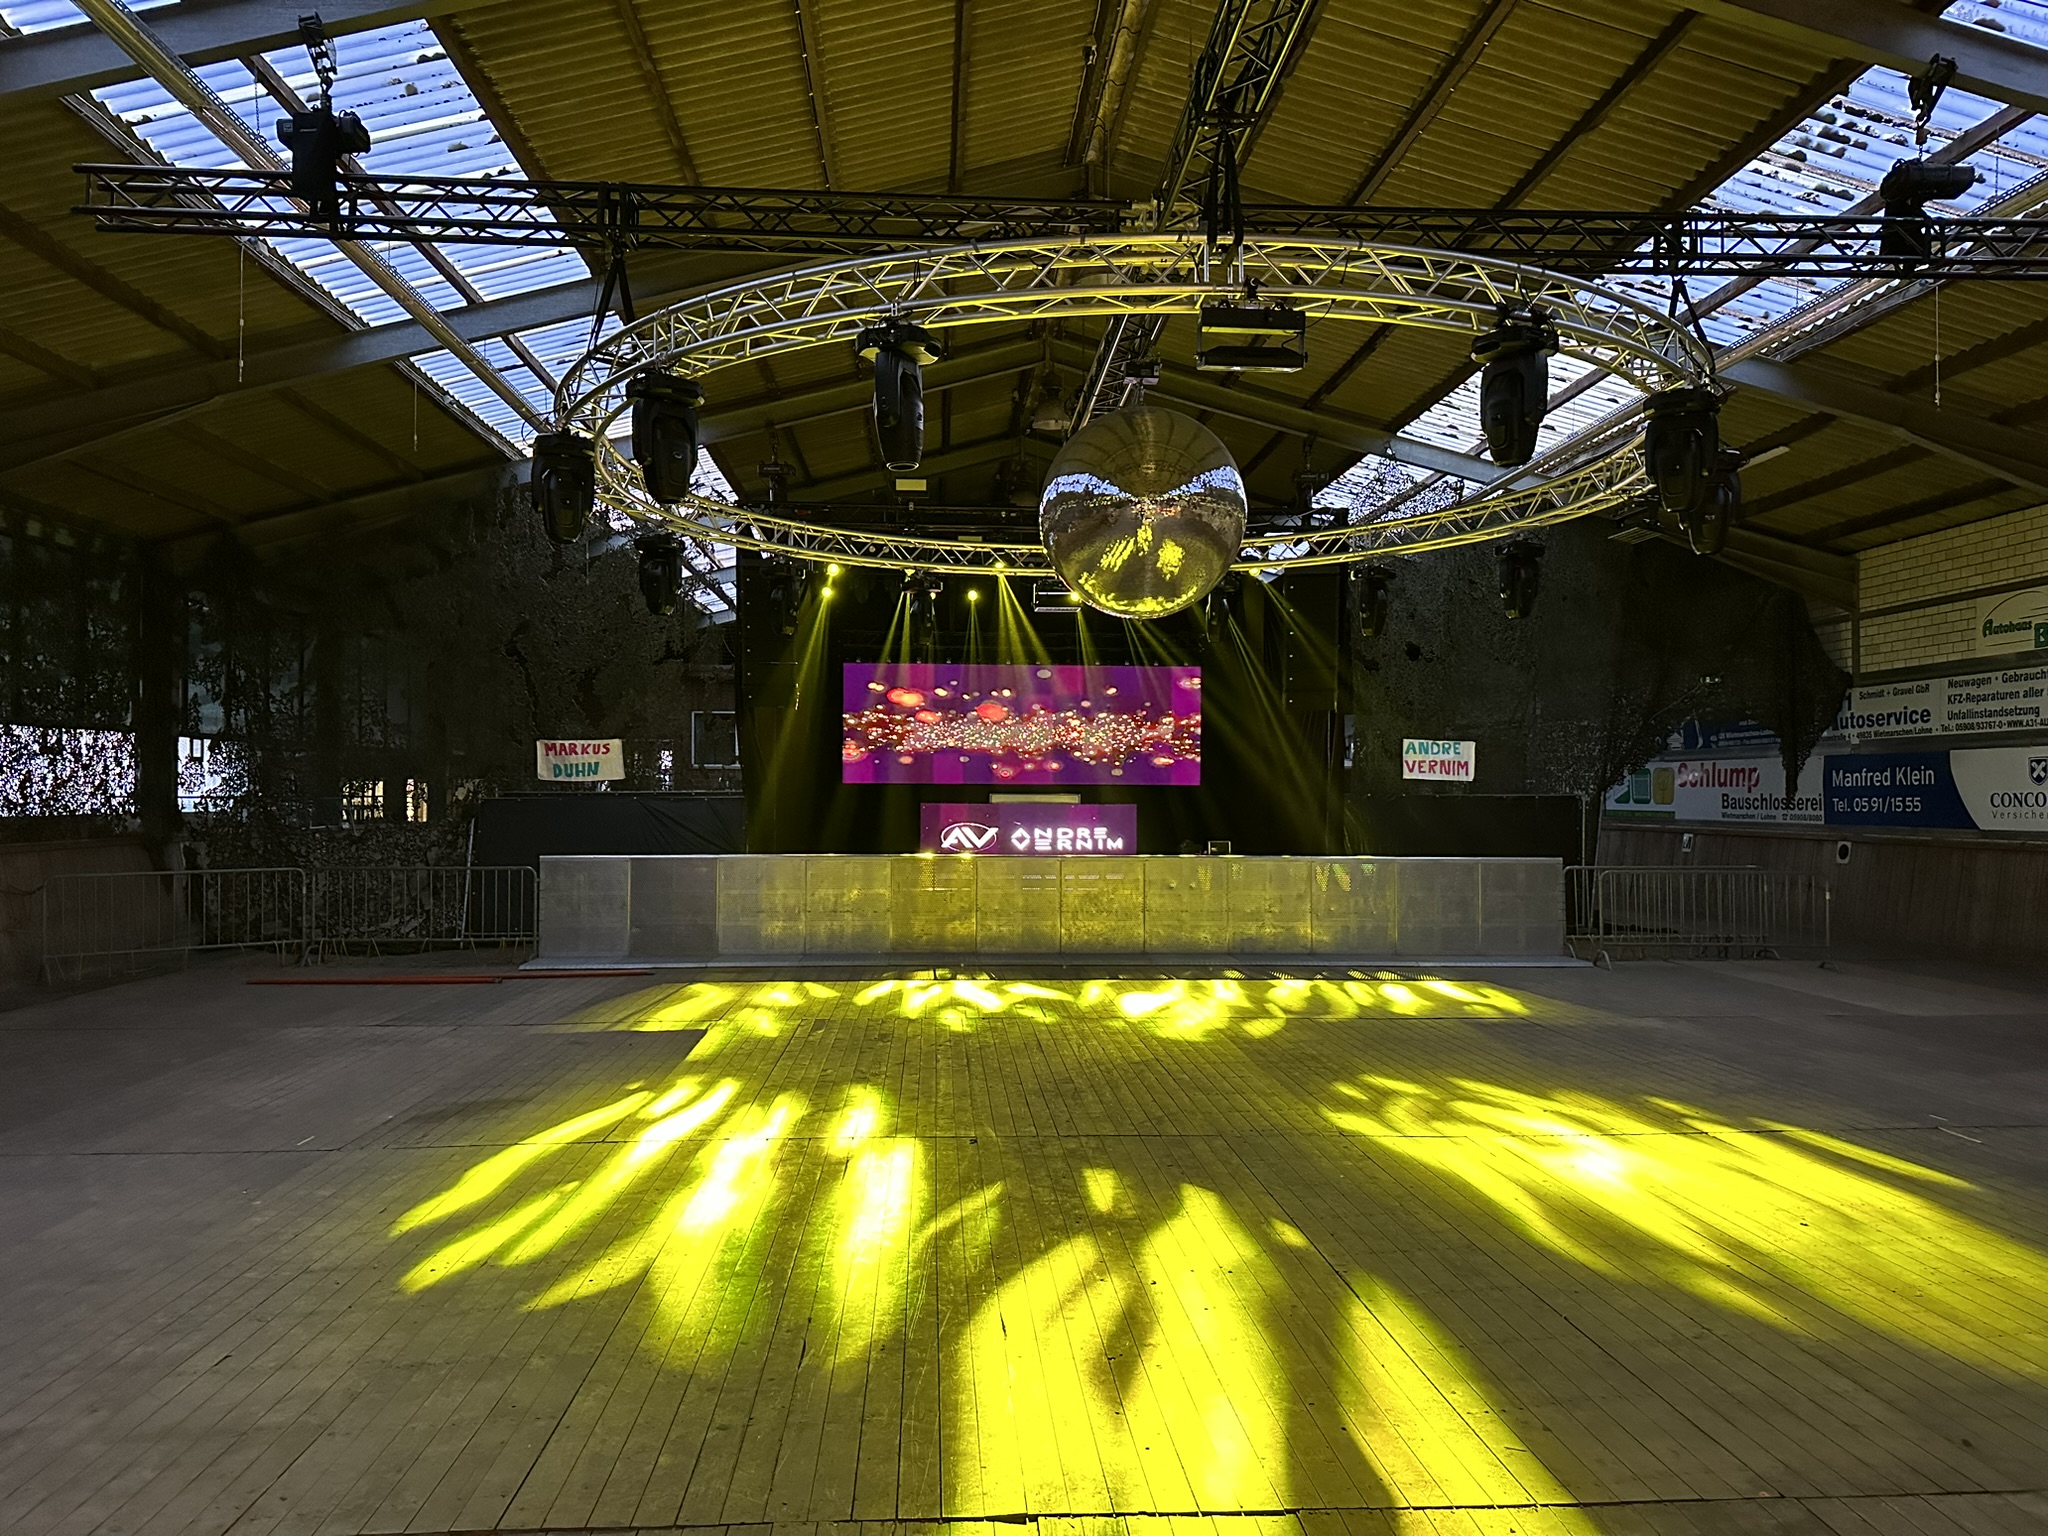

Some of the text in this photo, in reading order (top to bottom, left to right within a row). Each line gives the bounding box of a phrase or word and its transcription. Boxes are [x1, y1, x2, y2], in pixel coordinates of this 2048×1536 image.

[1982, 618, 2032, 638] Autohaus
[1947, 668, 2048, 689] Neuwagen Gebrauch
[1859, 690, 1885, 700] Schmidt
[1892, 685, 1914, 696] Gravel
[1915, 683, 1930, 694] GbR
[1947, 687, 2044, 705] KFZ-Reparaturen aller
[1947, 705, 2040, 720] Unfallinstandsetzung
[544, 742, 611, 756] MARKUS
[1404, 741, 1461, 755] ANDRE
[552, 762, 600, 778] DUHN
[1404, 760, 1469, 776] VERNIM
[1832, 765, 1935, 787] Manfred Klein
[1678, 762, 1760, 793] Schlump
[1721, 793, 1823, 811] Bauschlosserei
[1832, 798, 1850, 812] Tel.
